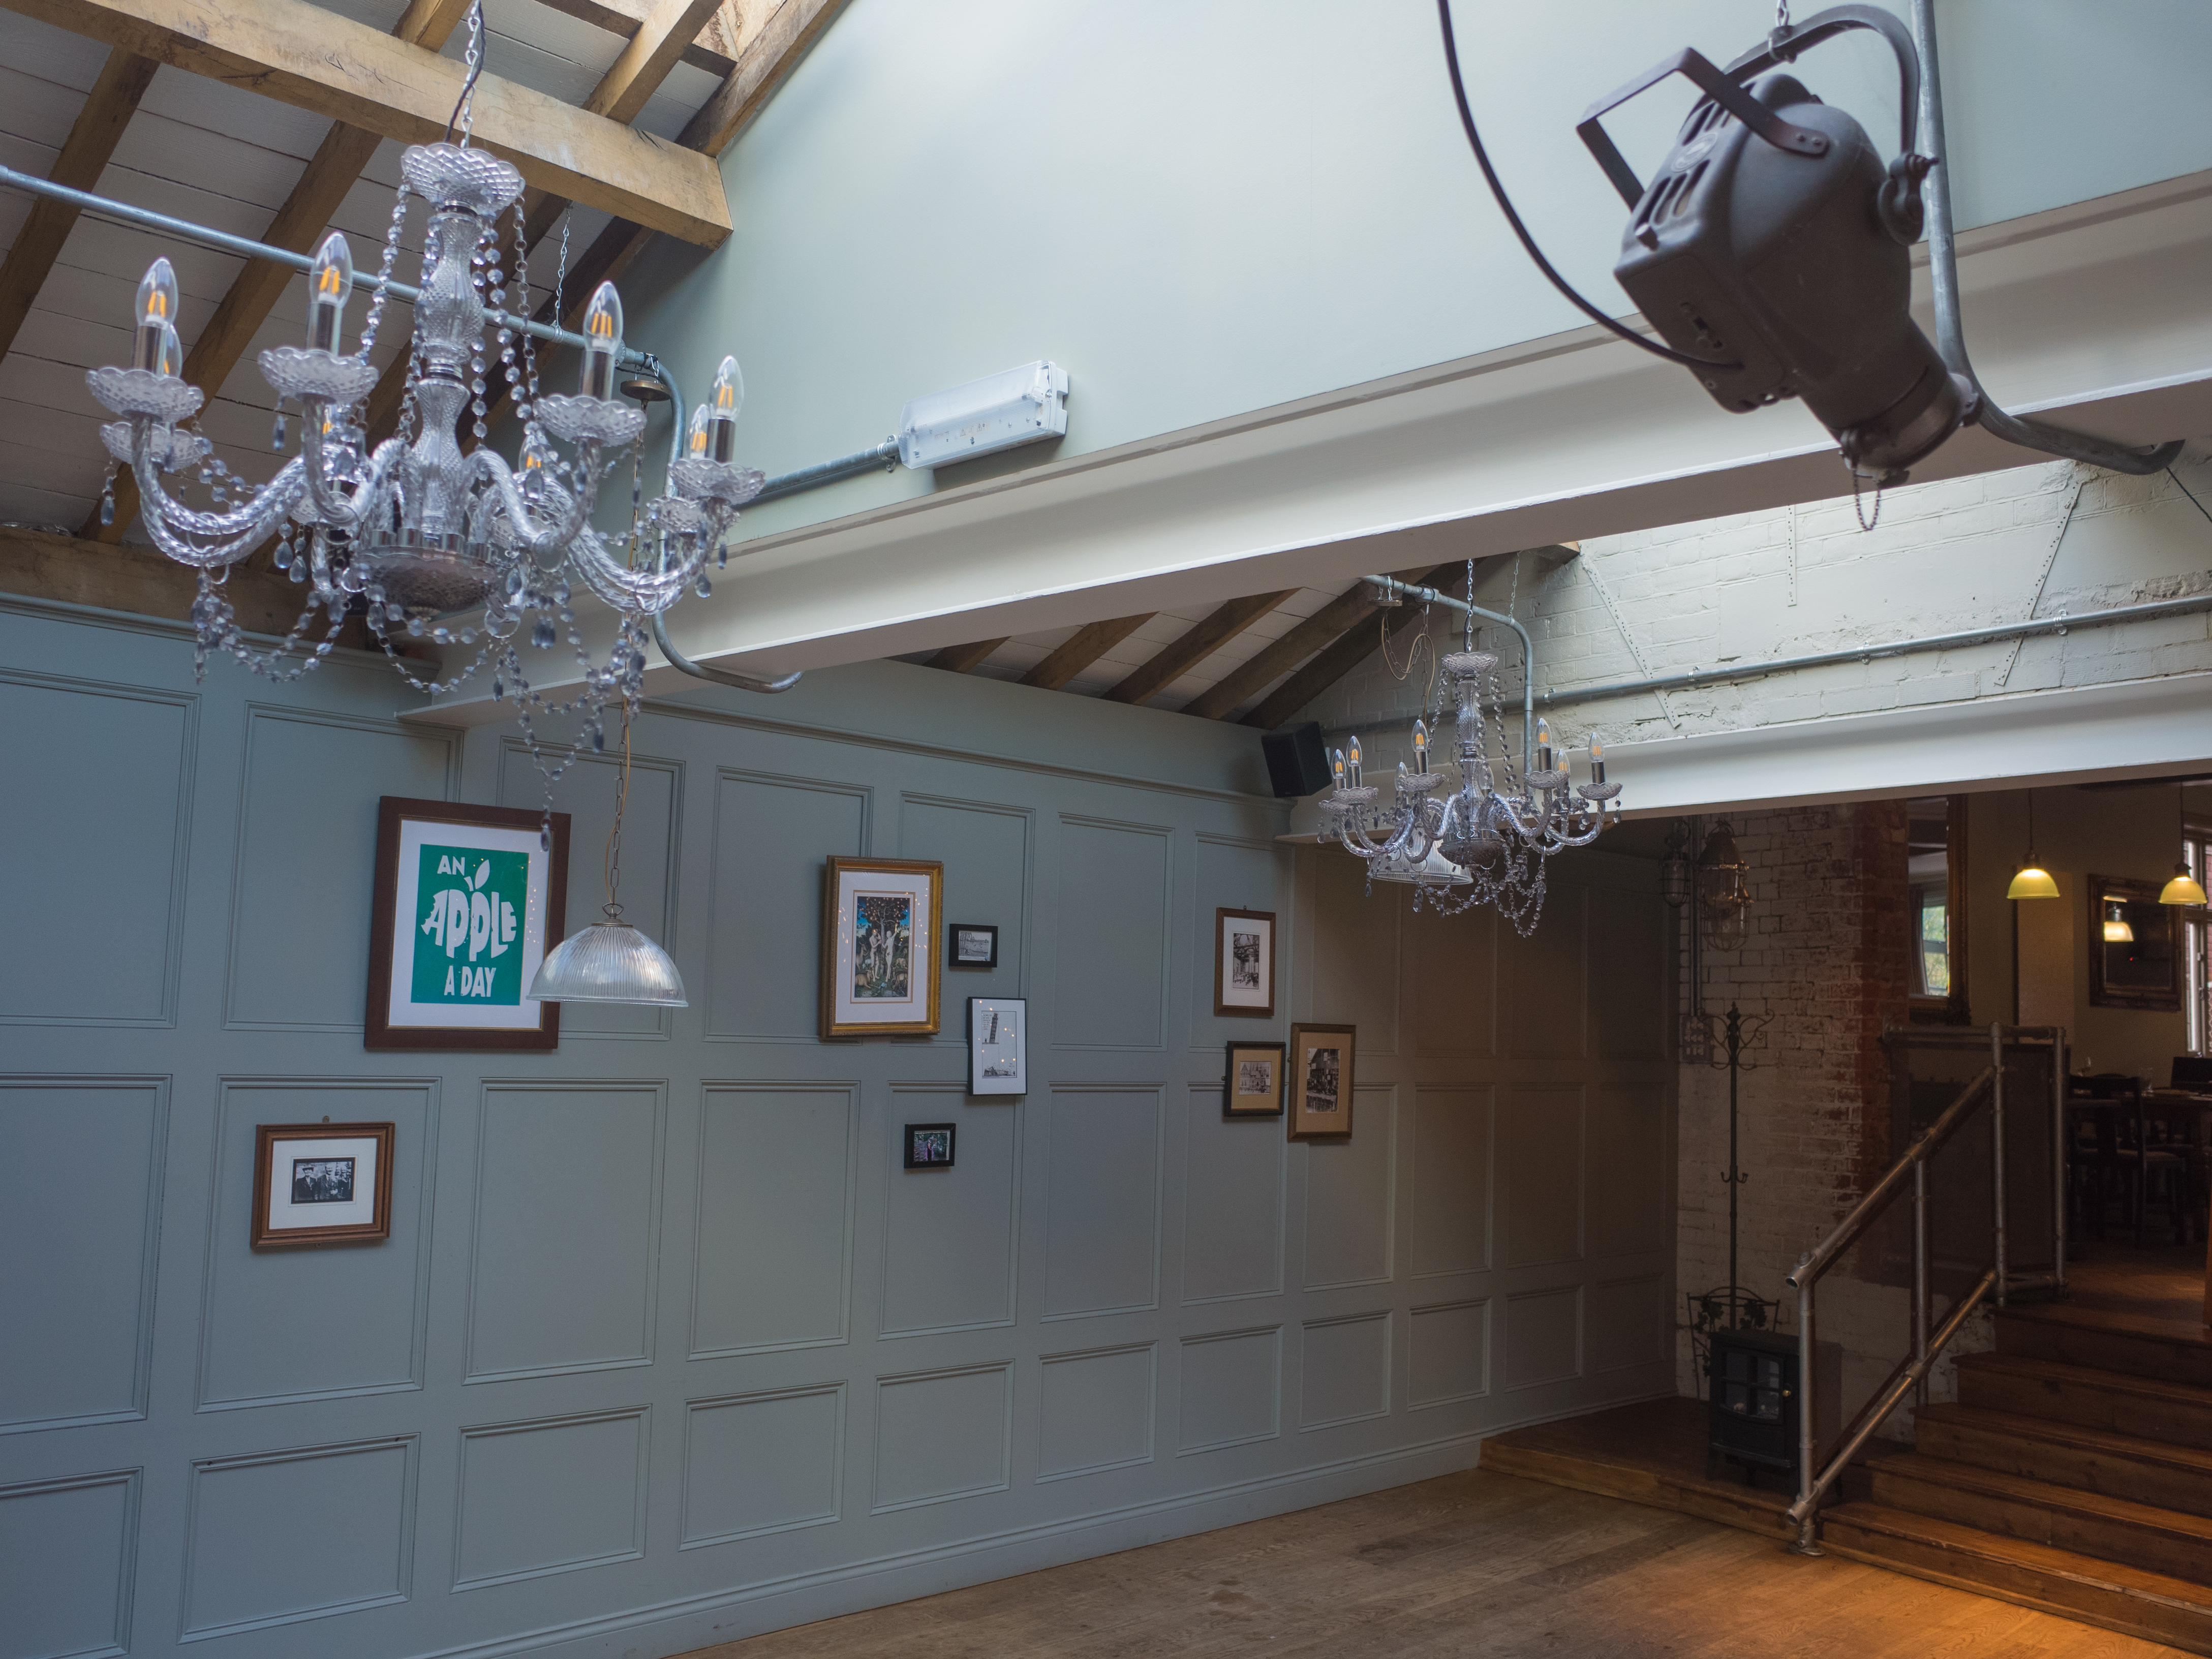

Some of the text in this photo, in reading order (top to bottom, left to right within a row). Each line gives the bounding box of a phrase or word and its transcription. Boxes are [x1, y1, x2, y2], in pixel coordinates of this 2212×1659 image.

[437, 855, 466, 876] AN
[421, 889, 516, 962] APPLE
[444, 965, 497, 997] A DAY
